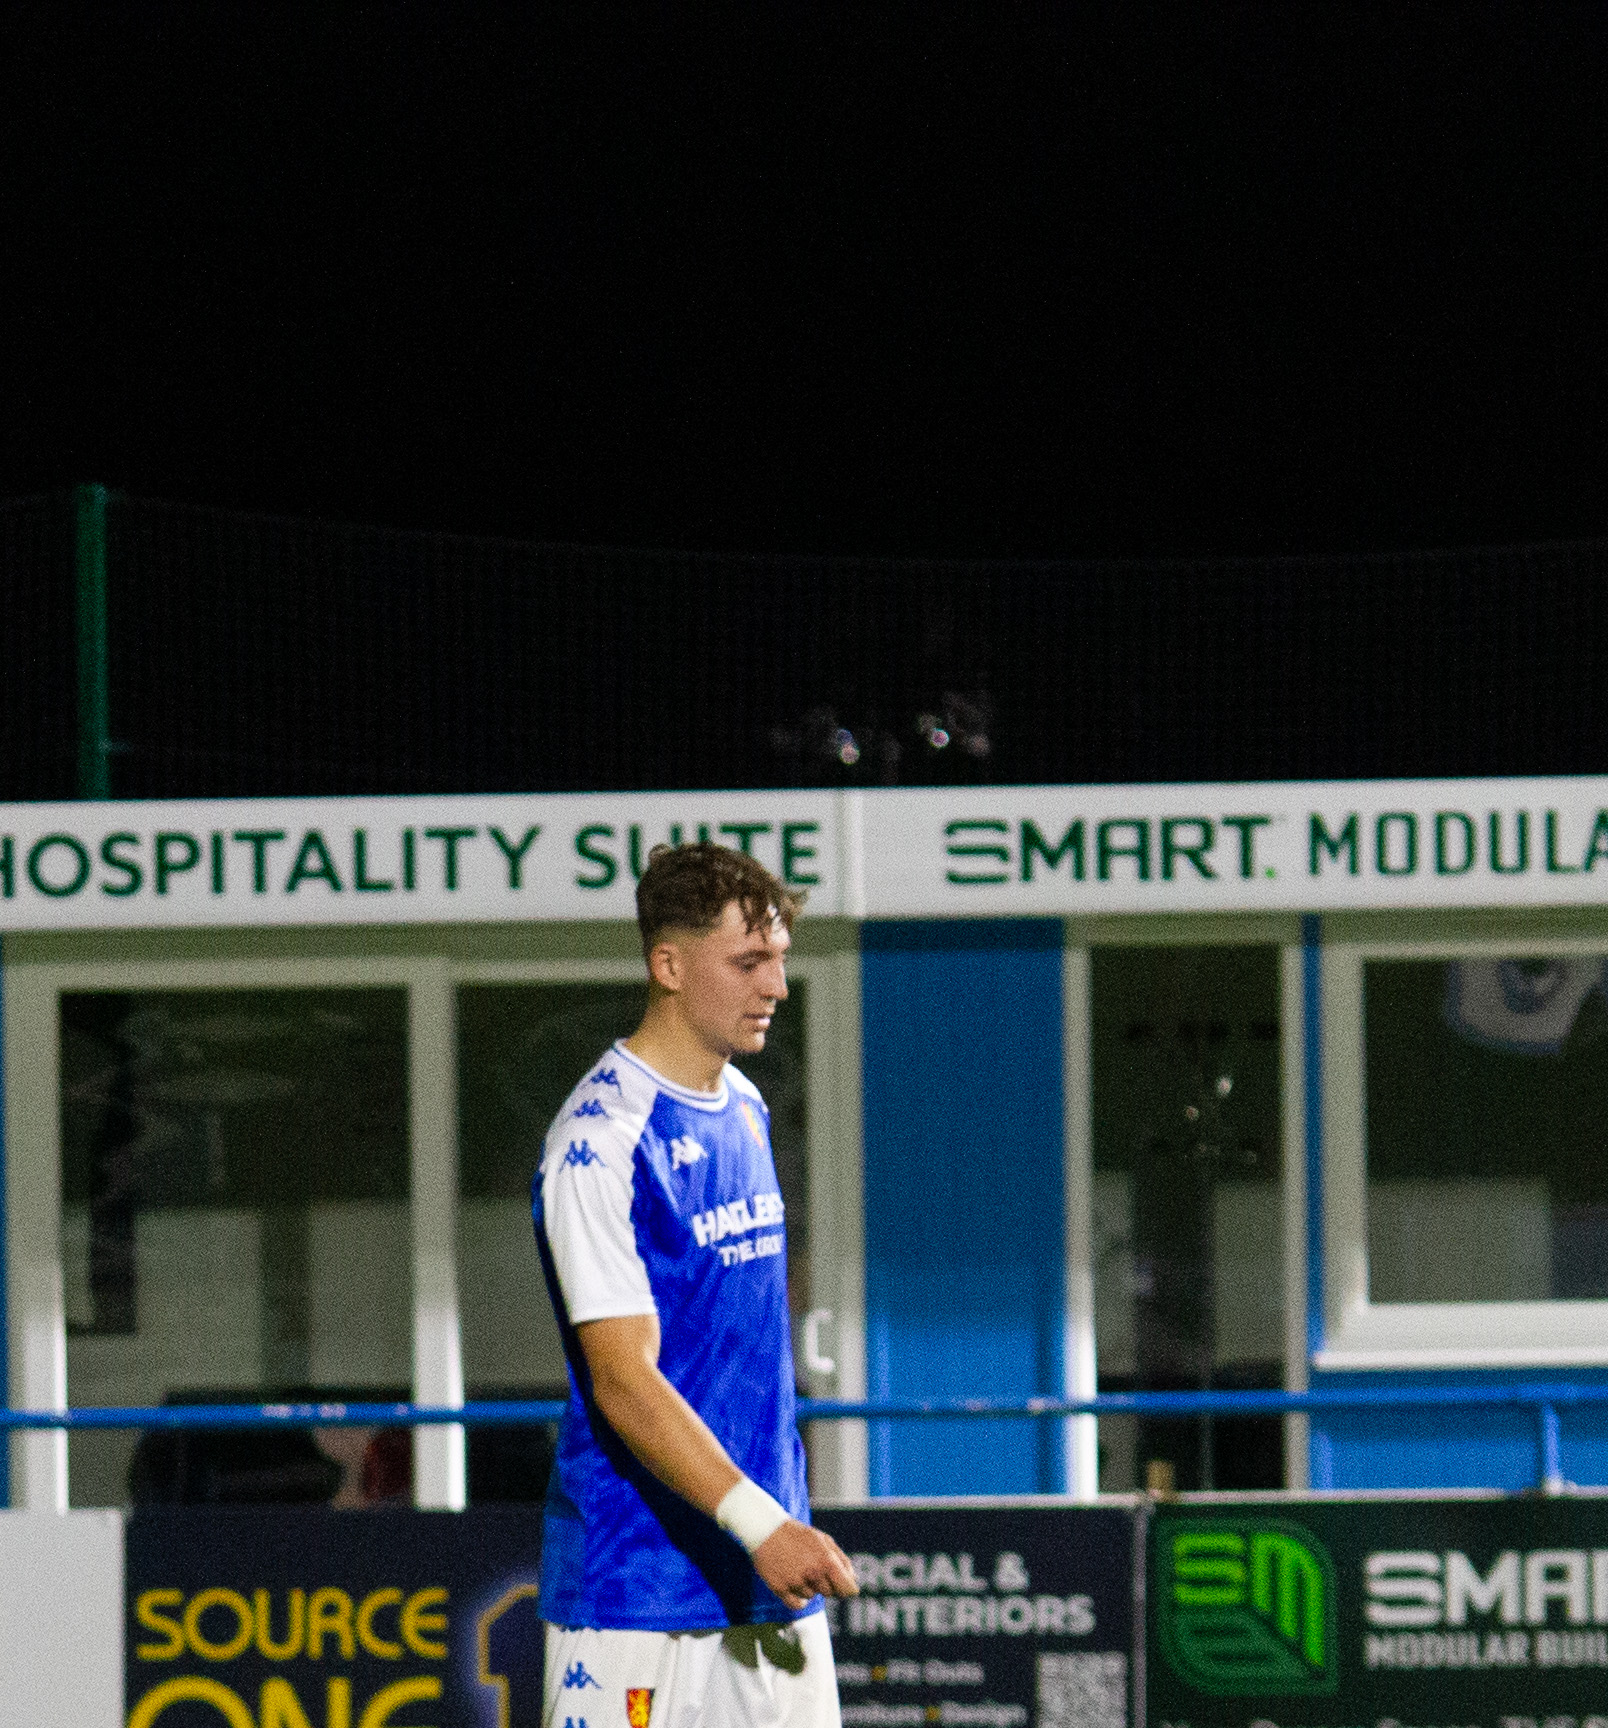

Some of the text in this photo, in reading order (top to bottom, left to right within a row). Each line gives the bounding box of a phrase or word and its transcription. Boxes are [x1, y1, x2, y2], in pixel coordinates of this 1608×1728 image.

[854, 1550, 1030, 1594] RCIAL &
[135, 1587, 449, 1662] SOURCE
[847, 1595, 1096, 1636] INTERIORS
[1363, 1631, 1529, 1671] MODULAR
